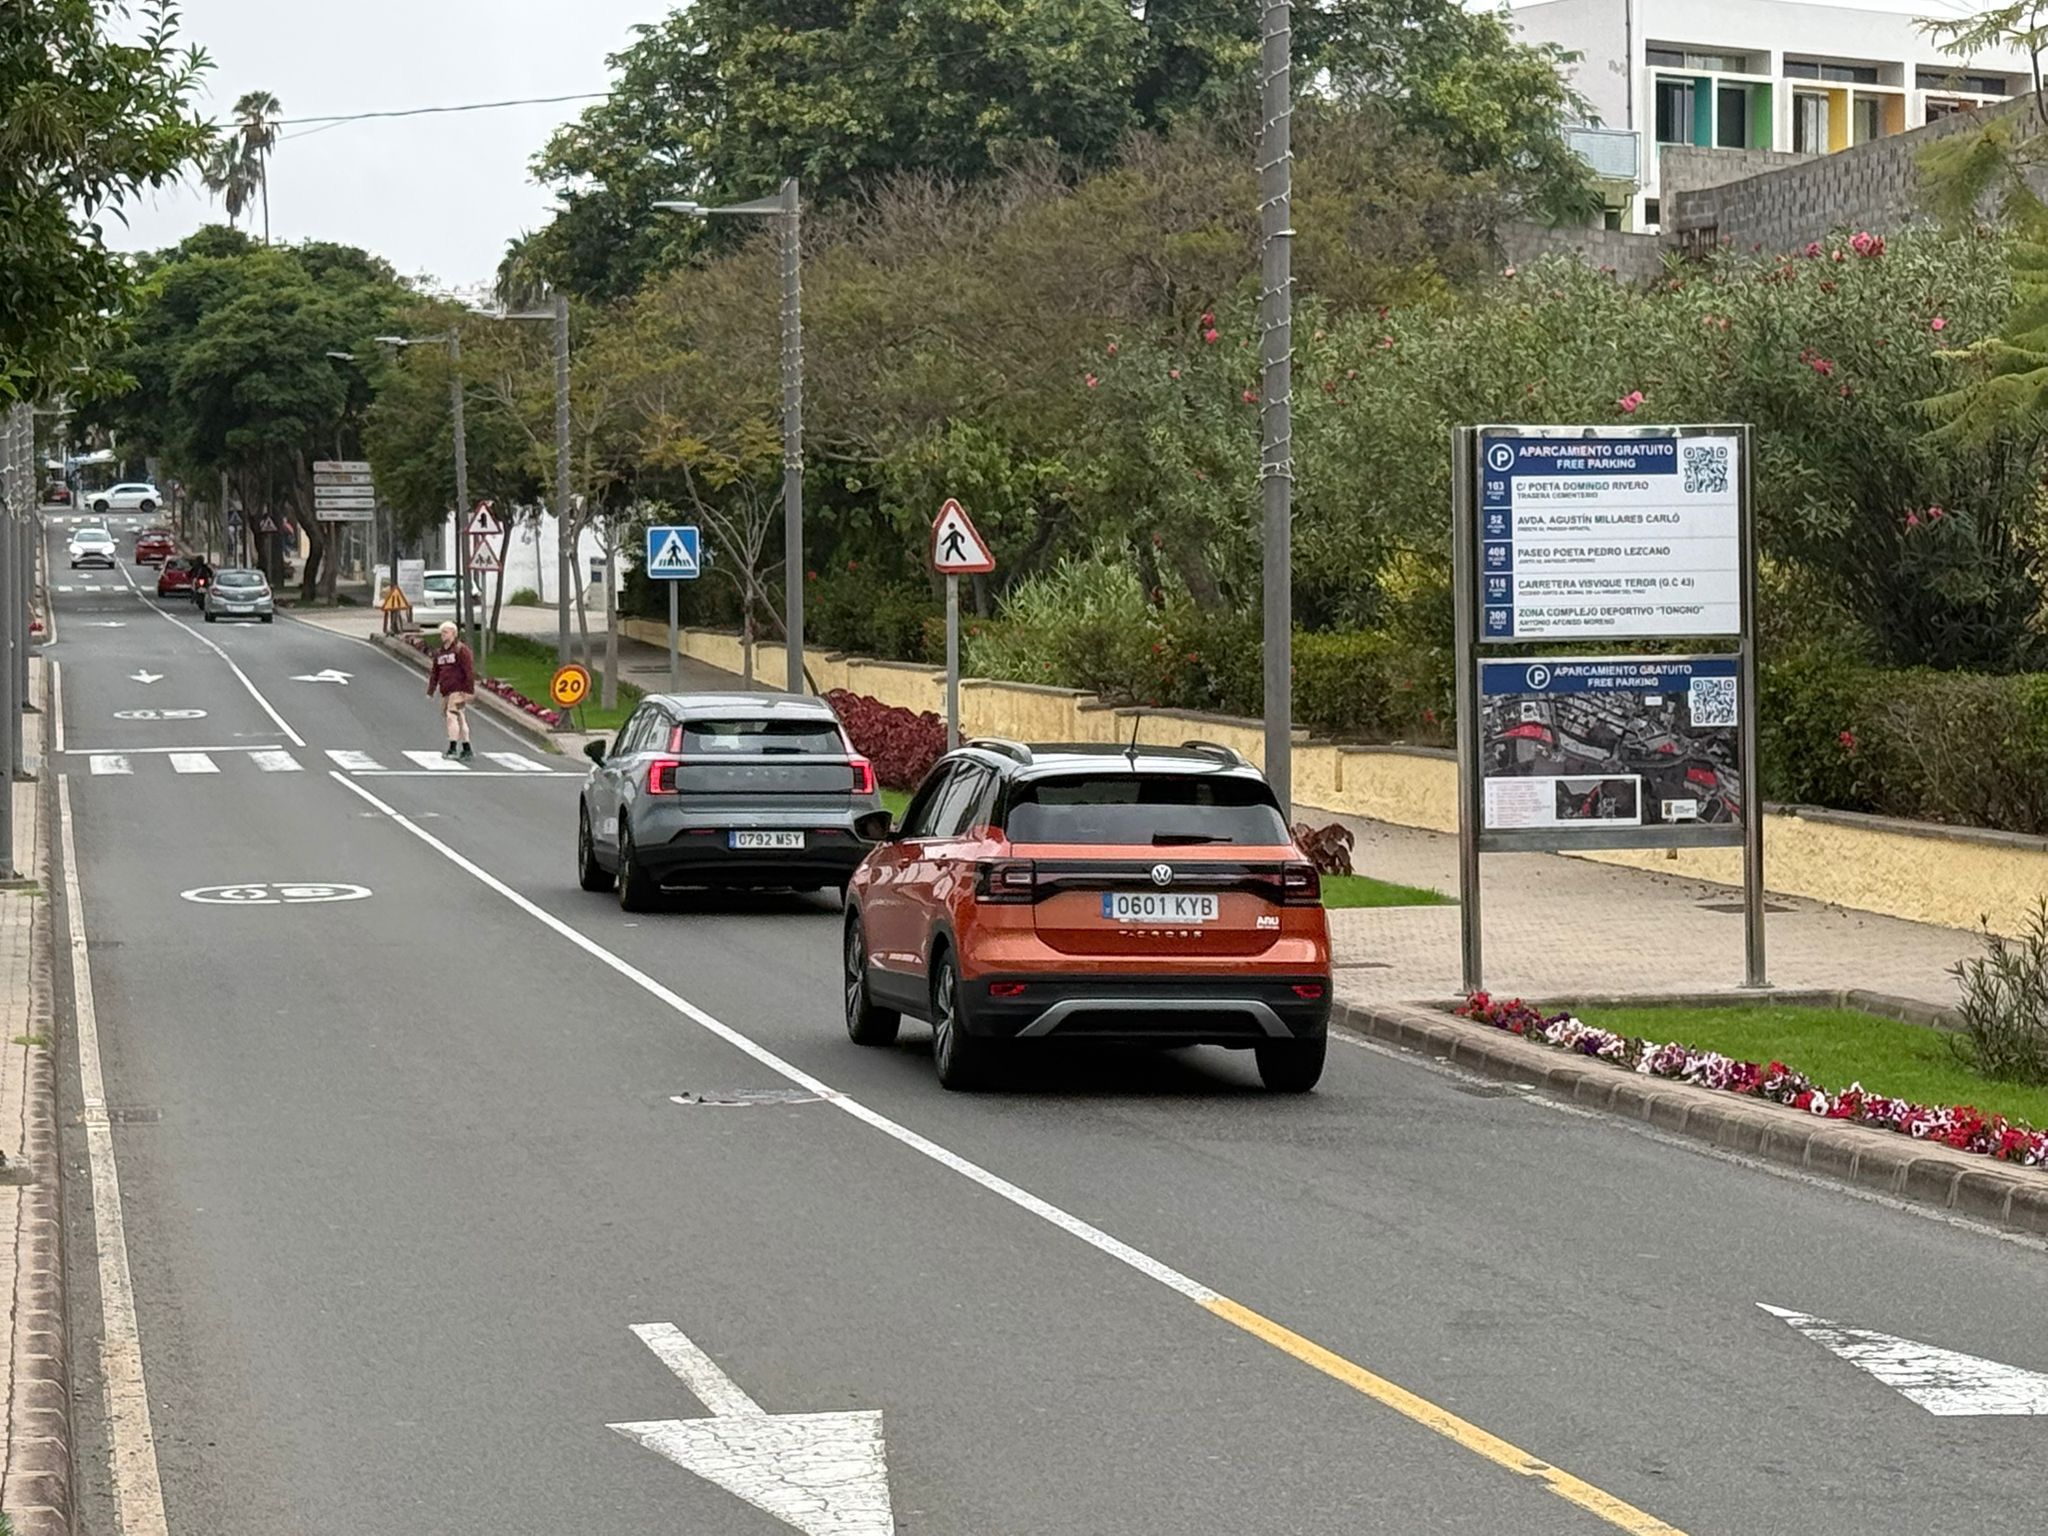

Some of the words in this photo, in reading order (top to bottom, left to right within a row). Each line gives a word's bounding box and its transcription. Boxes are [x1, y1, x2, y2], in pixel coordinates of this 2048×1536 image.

[1519, 445, 1612, 457] APARCAMIENTO
[1614, 444, 1673, 456] GRATUITO
[1556, 459, 1585, 470] FREE
[1588, 458, 1636, 469] PARKING
[1516, 482, 1527, 491] C/
[1528, 482, 1561, 491] POETA
[1563, 481, 1609, 490] DOMINGO
[1612, 481, 1649, 490] RIVERO
[1549, 513, 1592, 524] AGUSTÍN
[1595, 515, 1643, 524] MILLARES
[1645, 512, 1680, 523] CARLÓ
[1518, 548, 1551, 558] PASEO
[1553, 548, 1585, 557] POETA
[1588, 547, 1621, 557] PEDRO
[1624, 546, 1670, 556] LEZCANO
[1518, 580, 1576, 589] CARRETERA
[1625, 578, 1657, 588] TEROR
[1518, 608, 1545, 618] ZONA
[1546, 607, 1598, 617] COMPLEJO
[1600, 607, 1654, 616] DEPORTIVO
[1554, 666, 1637, 676] APARCAMIENTO
[1640, 665, 1692, 675] GRATUITO
[558, 679, 581, 693] 20
[1588, 678, 1612, 687] FREE
[1616, 677, 1659, 687] PARKING
[738, 834, 771, 846] 0792
[776, 834, 801, 846] MSY
[1118, 896, 1166, 916] 0601
[1175, 897, 1213, 916] KYB
